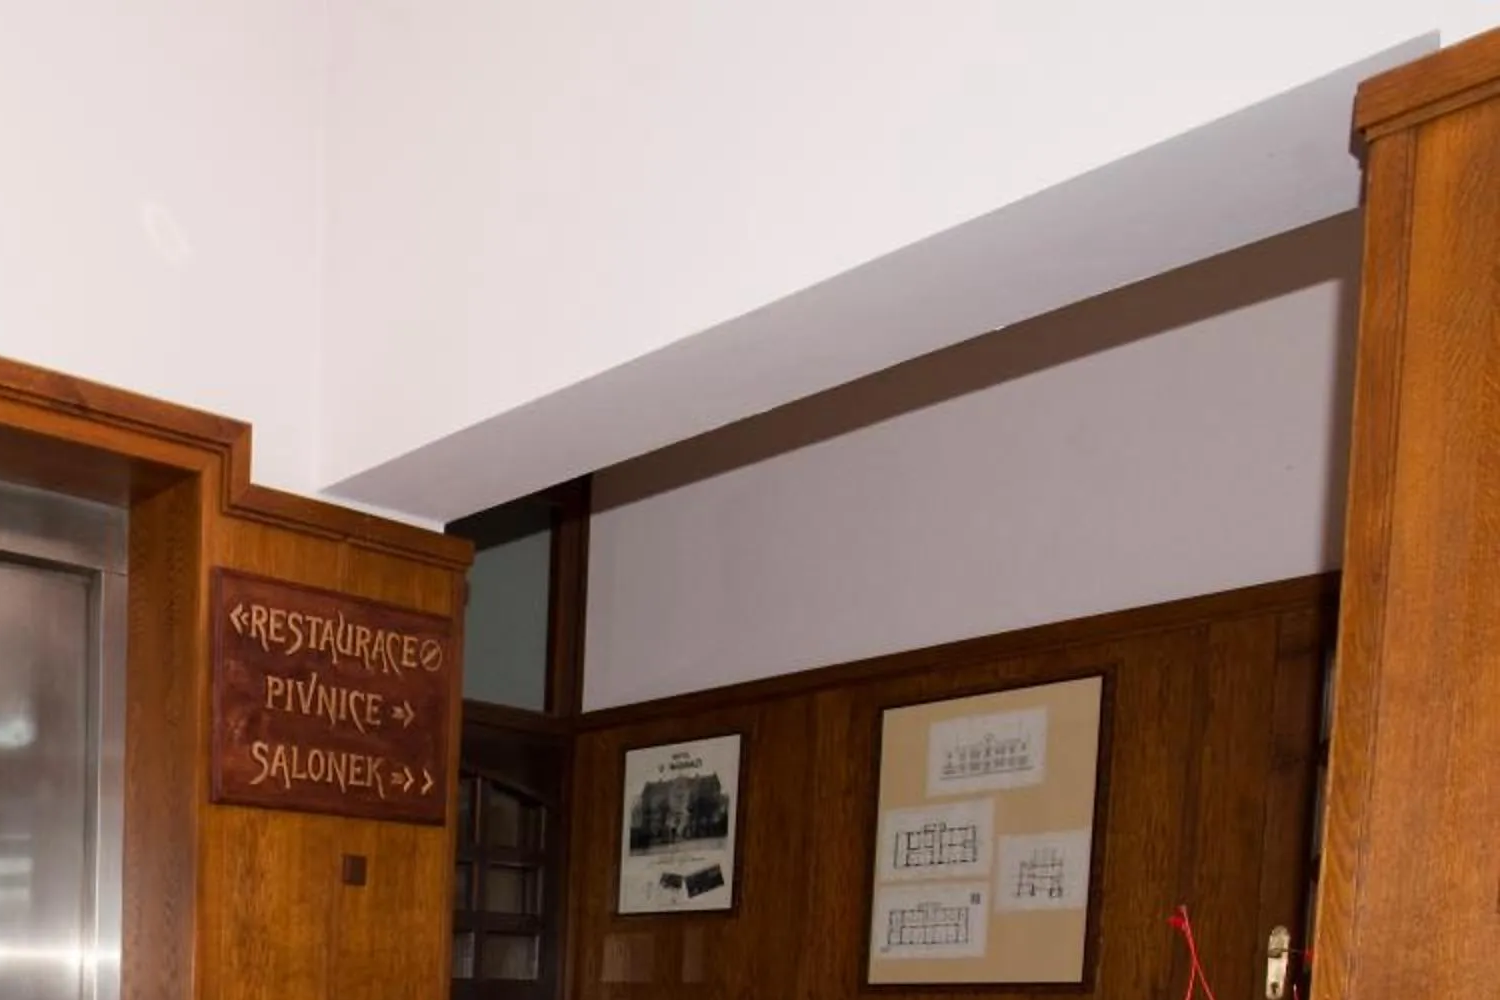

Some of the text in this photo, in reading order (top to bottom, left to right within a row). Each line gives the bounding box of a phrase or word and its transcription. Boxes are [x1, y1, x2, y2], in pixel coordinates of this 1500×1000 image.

[251, 604, 417, 675] RESTAURACE
[265, 672, 382, 734] PIVNICE
[251, 741, 385, 798] SALONEK
